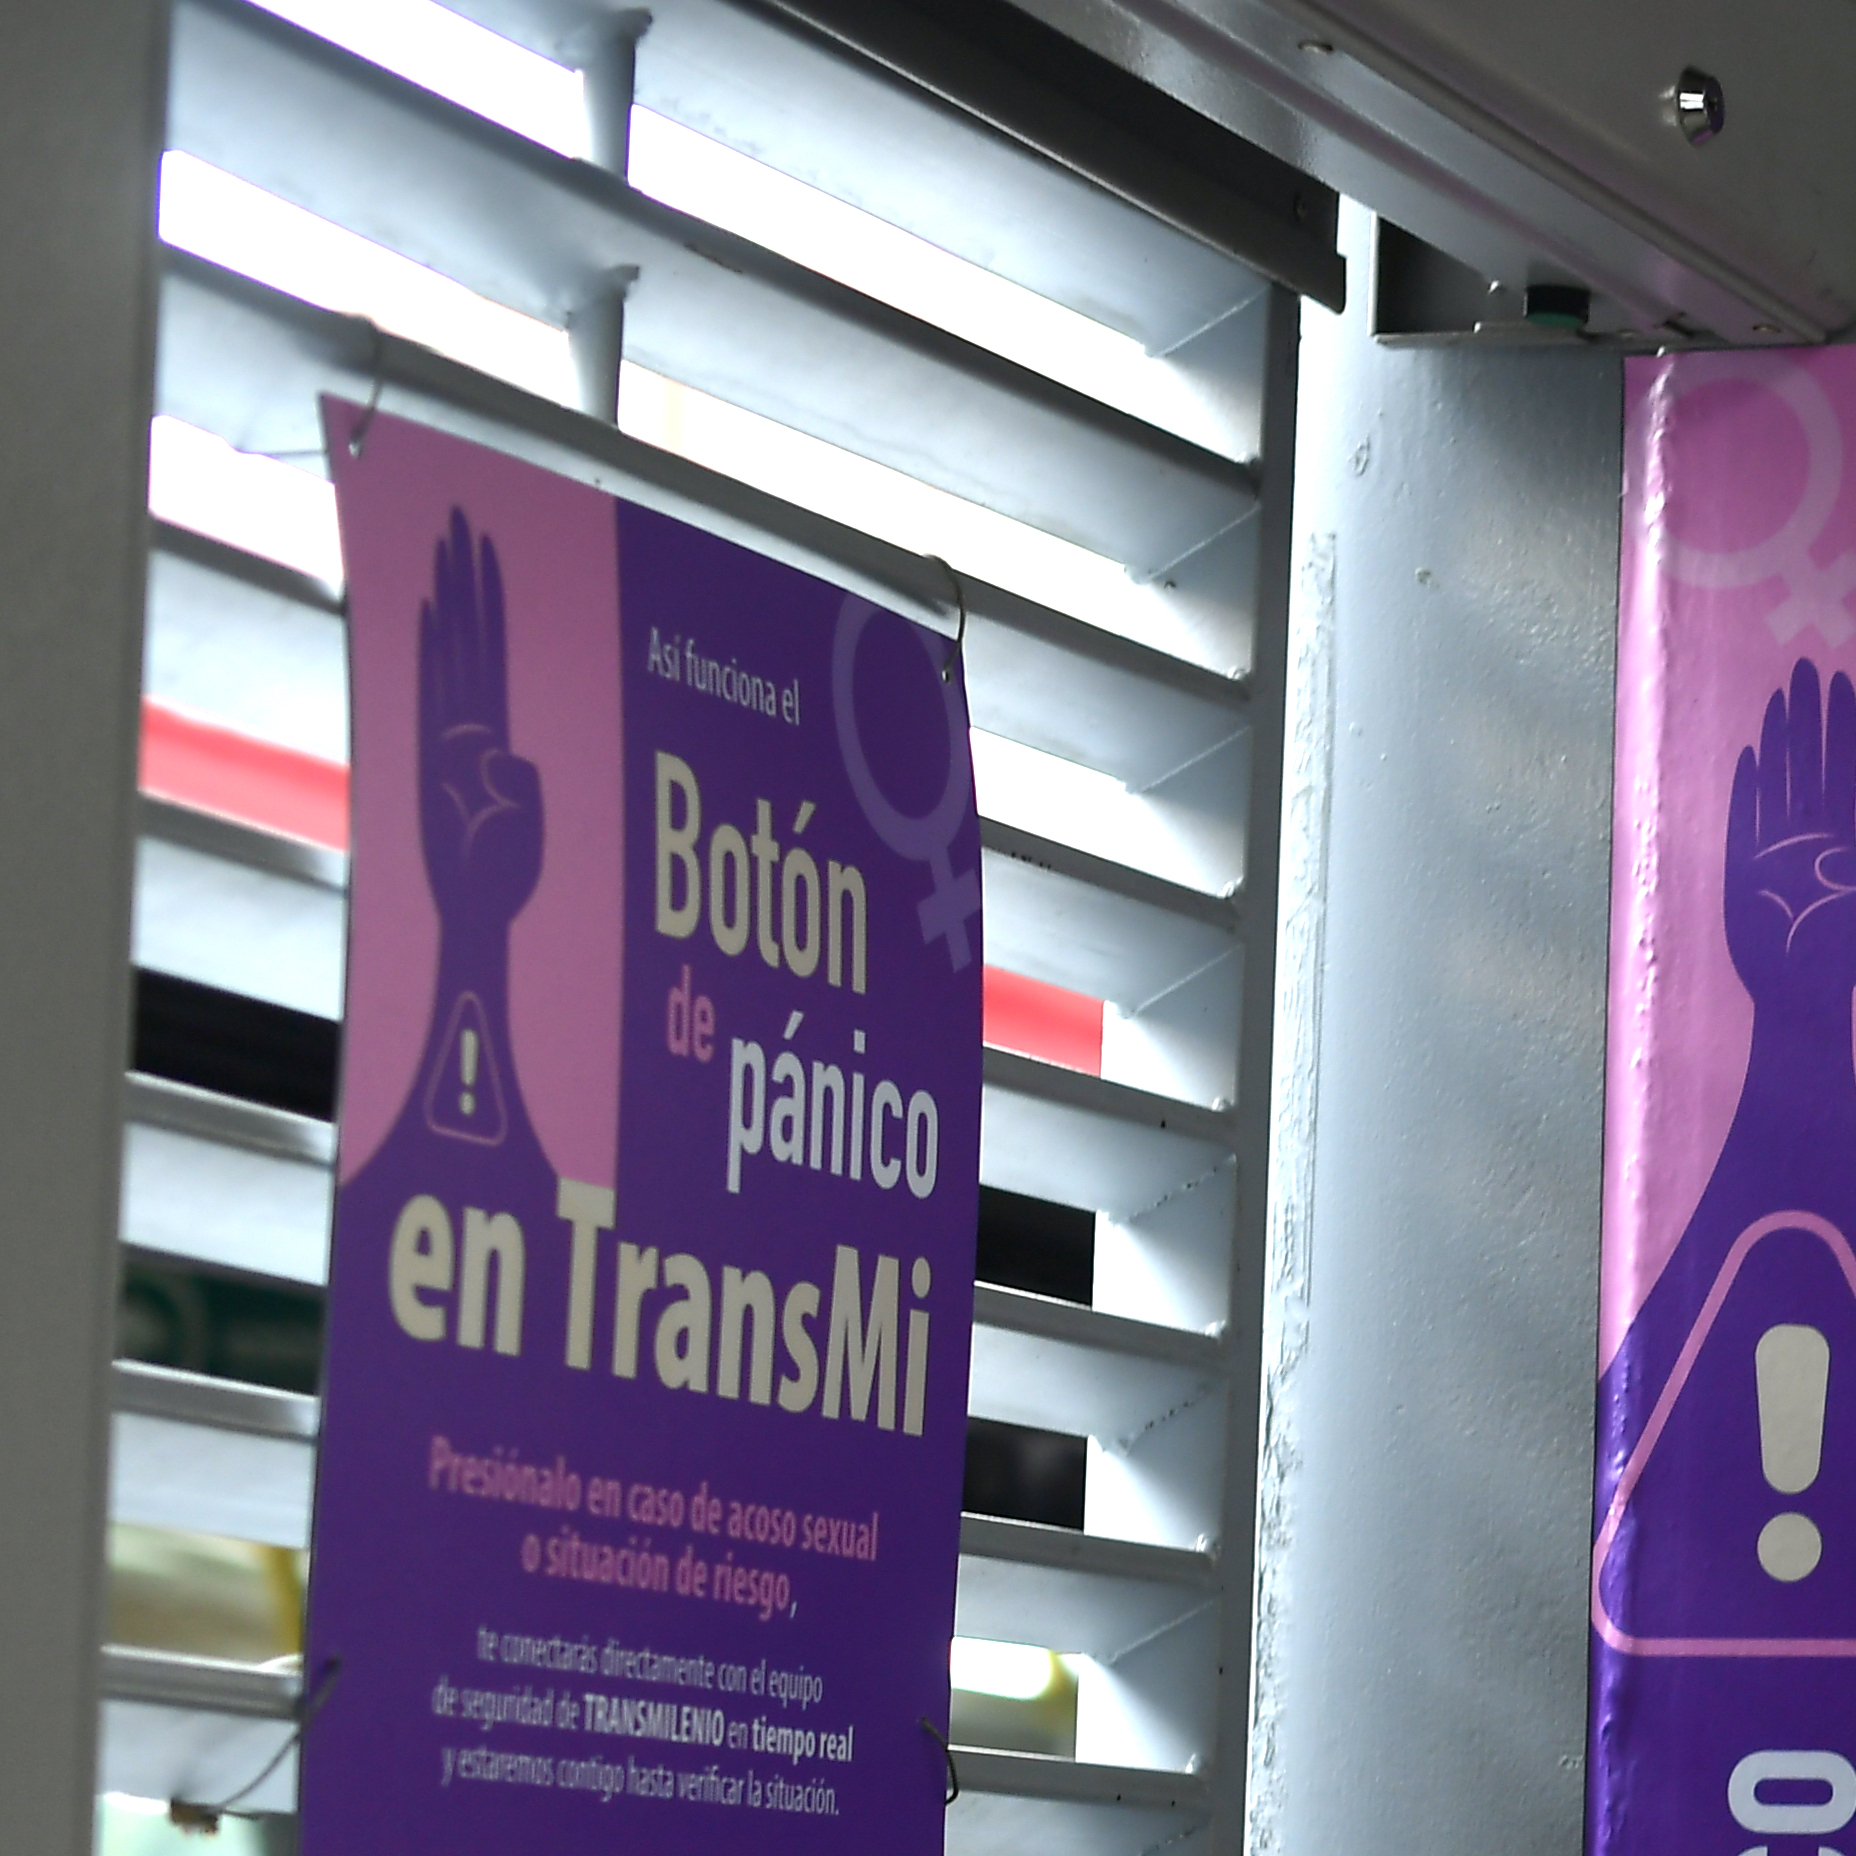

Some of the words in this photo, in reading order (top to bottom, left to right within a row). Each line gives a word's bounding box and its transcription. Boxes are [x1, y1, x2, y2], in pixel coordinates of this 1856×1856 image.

[686, 638, 777, 717] funciona
[782, 678, 800, 726] el
[655, 749, 867, 995] Botón
[668, 964, 716, 1062] de
[725, 1010, 939, 1198] pánico
[388, 1192, 526, 1357] en
[556, 1176, 931, 1438] TransMi
[429, 1435, 582, 1511] Presiónalo
[588, 1476, 622, 1518] en
[627, 1483, 685, 1528] caso
[691, 1480, 722, 1535] de
[727, 1501, 796, 1548] acoso
[801, 1511, 879, 1561] sexual
[521, 1533, 541, 1573] o
[546, 1523, 669, 1592] situación
[676, 1545, 707, 1597] de
[713, 1551, 798, 1622] riesgo,
[477, 1626, 498, 1662] te
[500, 1634, 598, 1674] conectarás
[601, 1637, 715, 1689] directamente
[717, 1663, 747, 1693] con
[751, 1658, 766, 1696] el
[769, 1665, 823, 1711] equipo
[432, 1674, 459, 1716] de
[460, 1685, 554, 1731] seguridad
[555, 1690, 580, 1730] de
[583, 1692, 725, 1746] TRANSMILENIO
[728, 1721, 748, 1749] en
[752, 1715, 816, 1766] tiempo
[819, 1725, 854, 1762] real
[441, 1748, 456, 1787] y
[457, 1743, 555, 1786] estaremos
[556, 1755, 625, 1803] contigo
[627, 1755, 674, 1799] hasta
[677, 1764, 745, 1805] verificar
[748, 1769, 761, 1808] la
[766, 1774, 840, 1816] situación.
